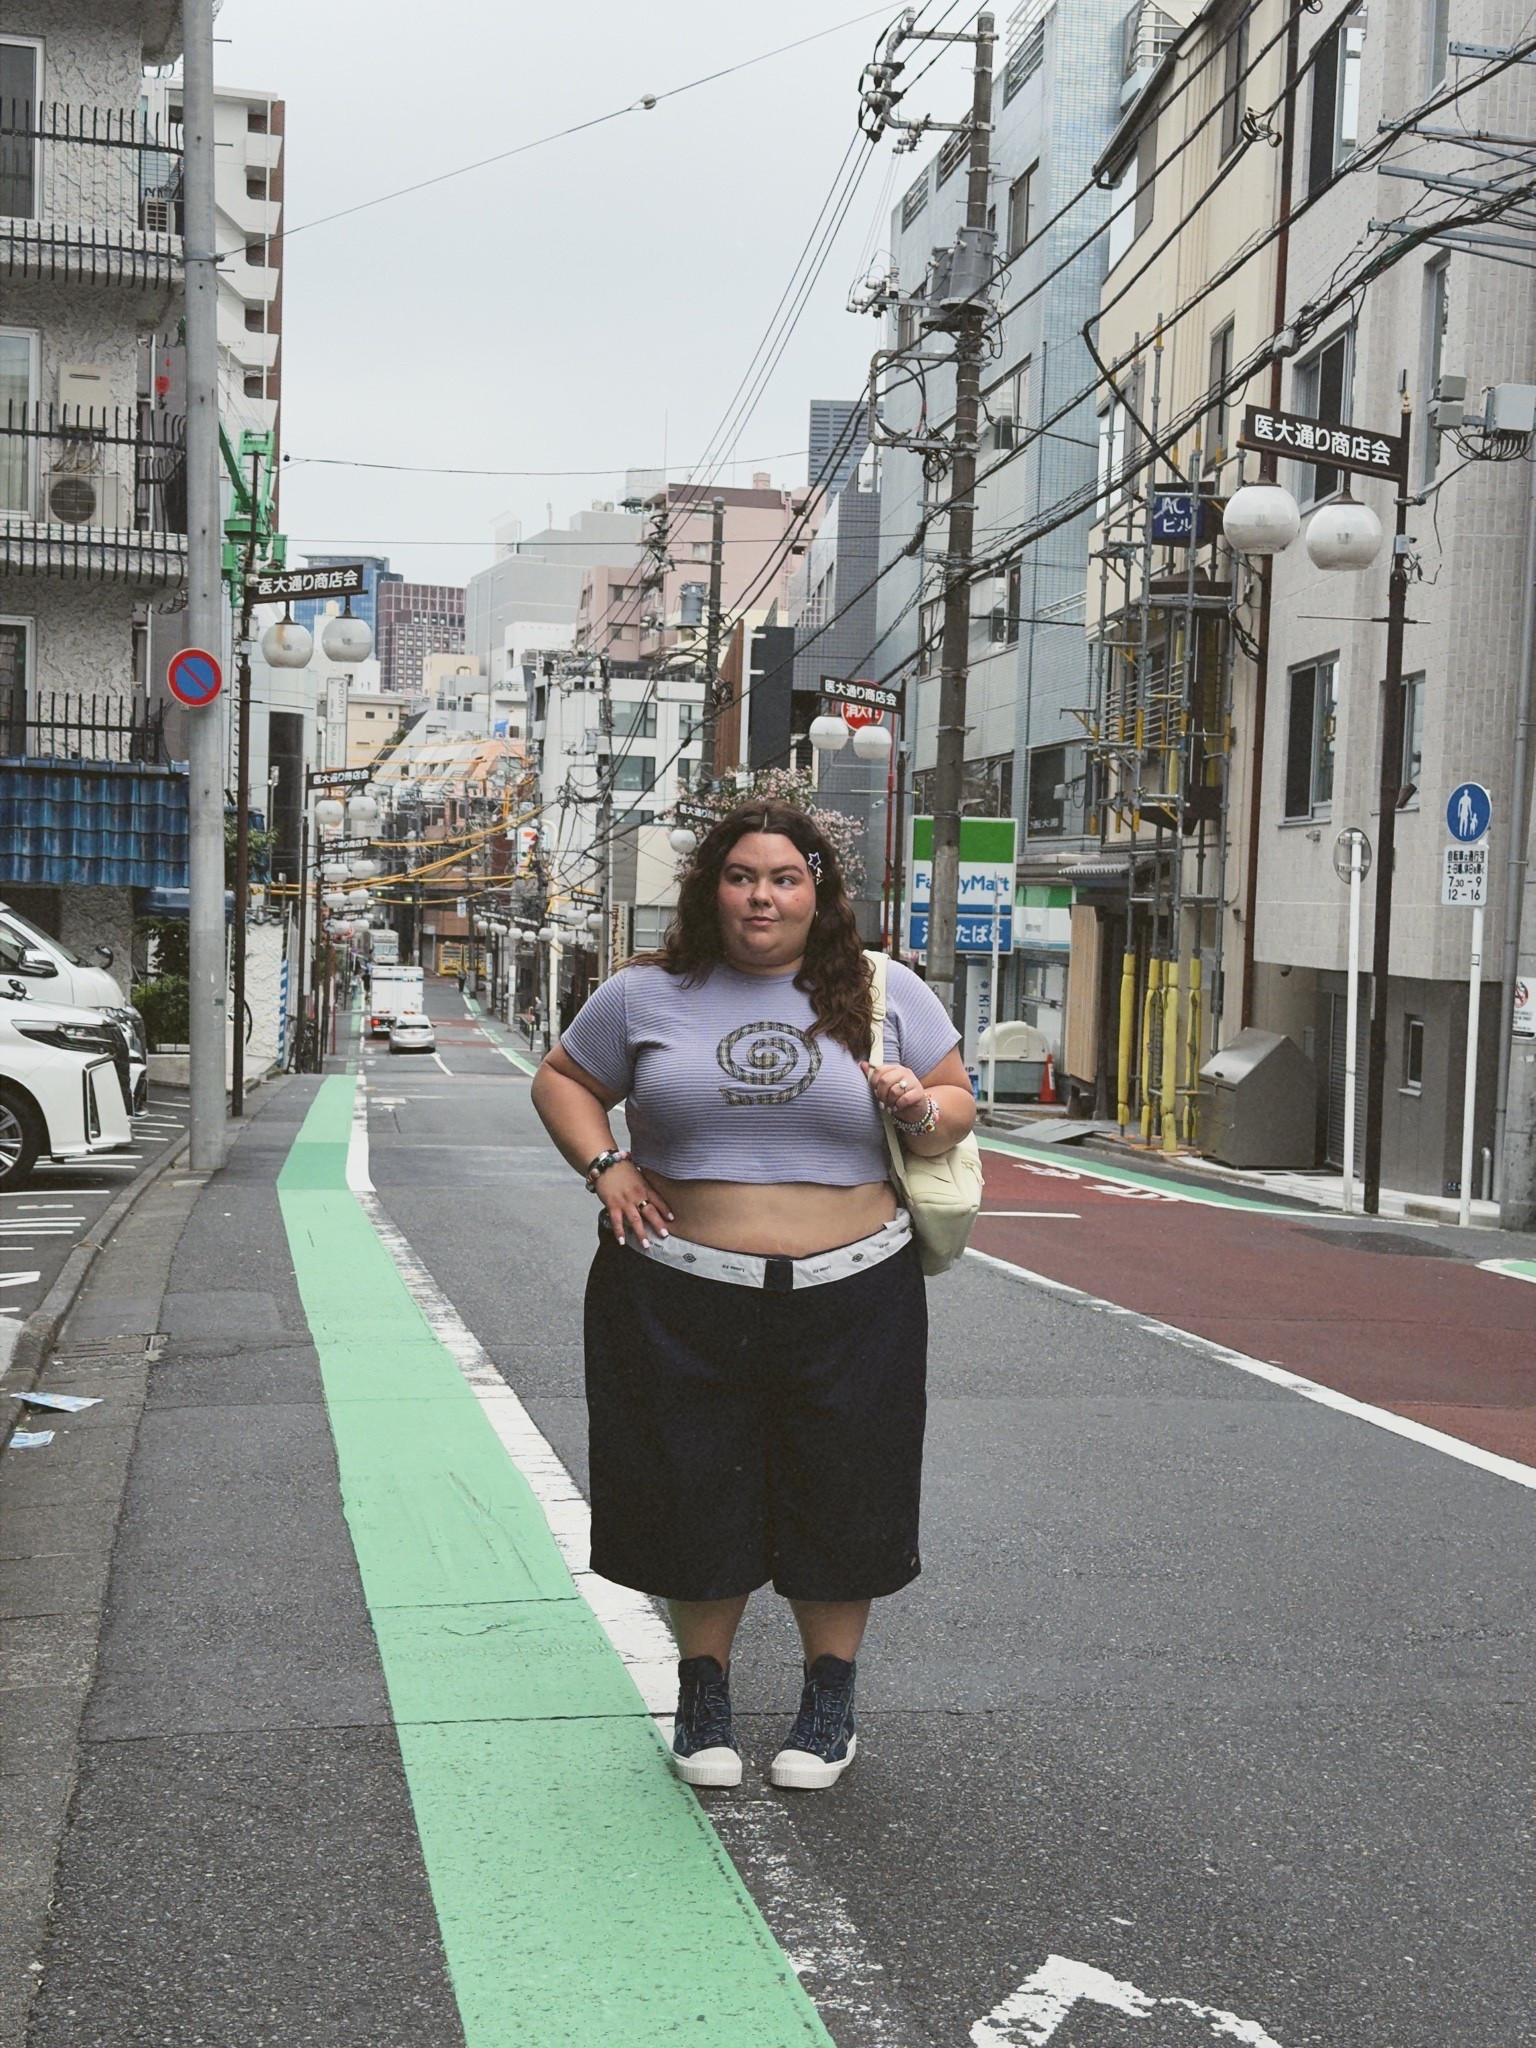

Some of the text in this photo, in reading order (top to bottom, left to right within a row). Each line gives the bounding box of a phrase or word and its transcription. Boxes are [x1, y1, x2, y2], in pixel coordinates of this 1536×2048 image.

[1254, 414, 1391, 466] 医大通り商店会
[258, 569, 358, 595] 医大通り商店会
[825, 679, 897, 707] 医大通り商店会
